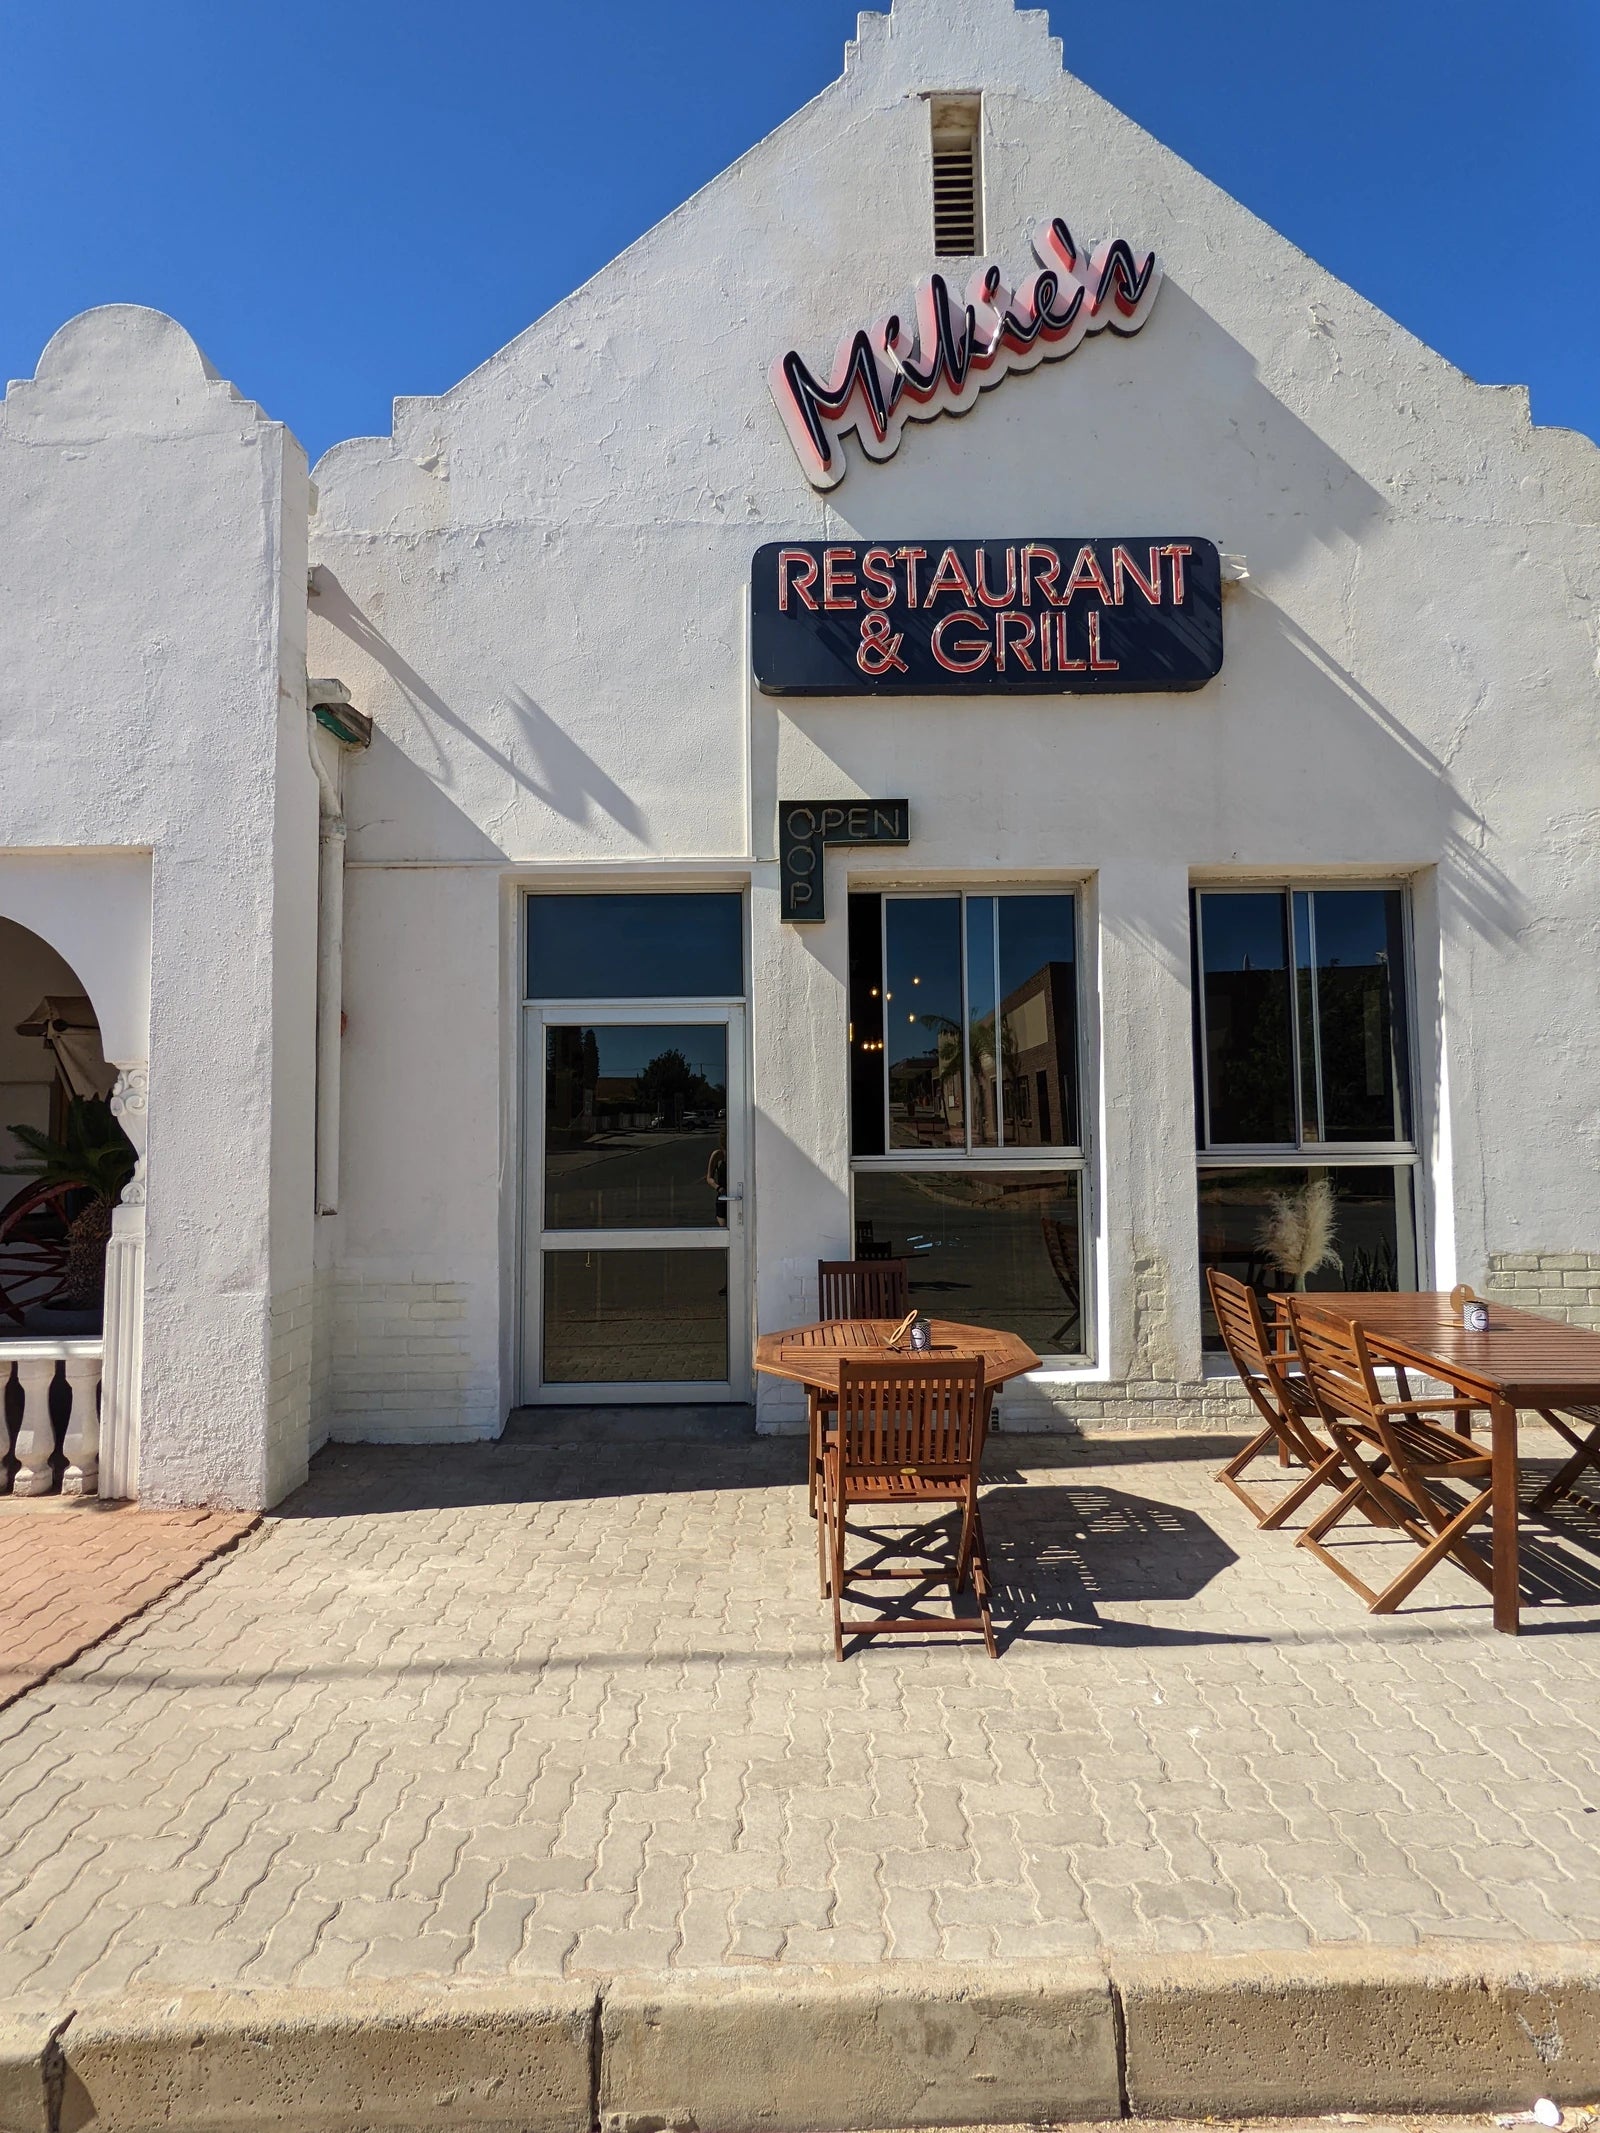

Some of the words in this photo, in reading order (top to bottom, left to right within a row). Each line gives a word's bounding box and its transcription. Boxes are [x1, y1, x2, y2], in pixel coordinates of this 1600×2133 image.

[778, 544, 1191, 611] RESTAURANT
[857, 610, 908, 674] &
[931, 610, 1119, 674] GRILL
[786, 807, 900, 840] OPEN
